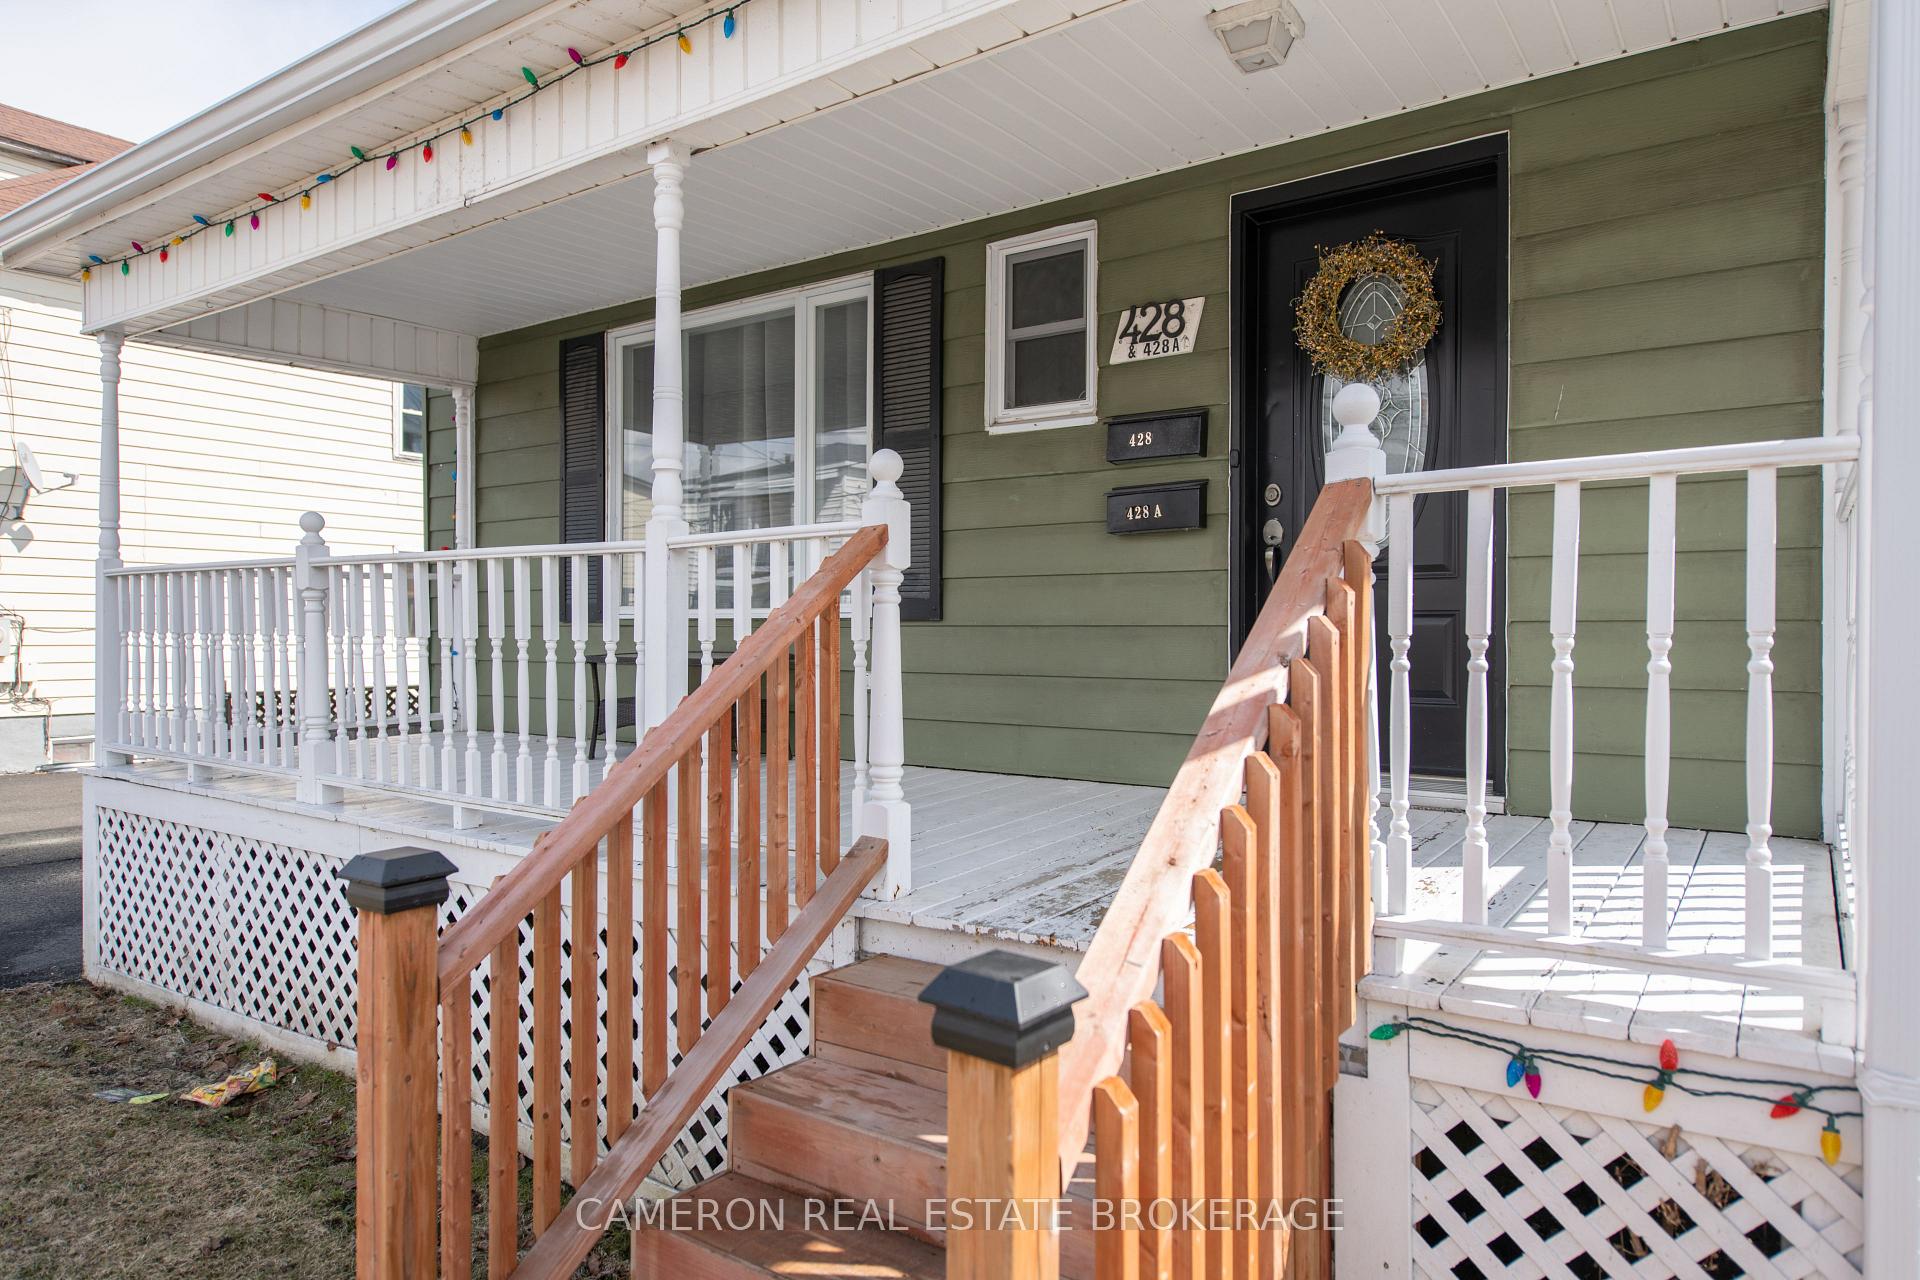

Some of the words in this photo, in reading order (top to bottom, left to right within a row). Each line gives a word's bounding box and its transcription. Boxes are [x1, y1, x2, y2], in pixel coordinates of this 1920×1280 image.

[1119, 300, 1185, 344] 428
[1128, 343, 1136, 359] &
[1129, 431, 1152, 447] 428
